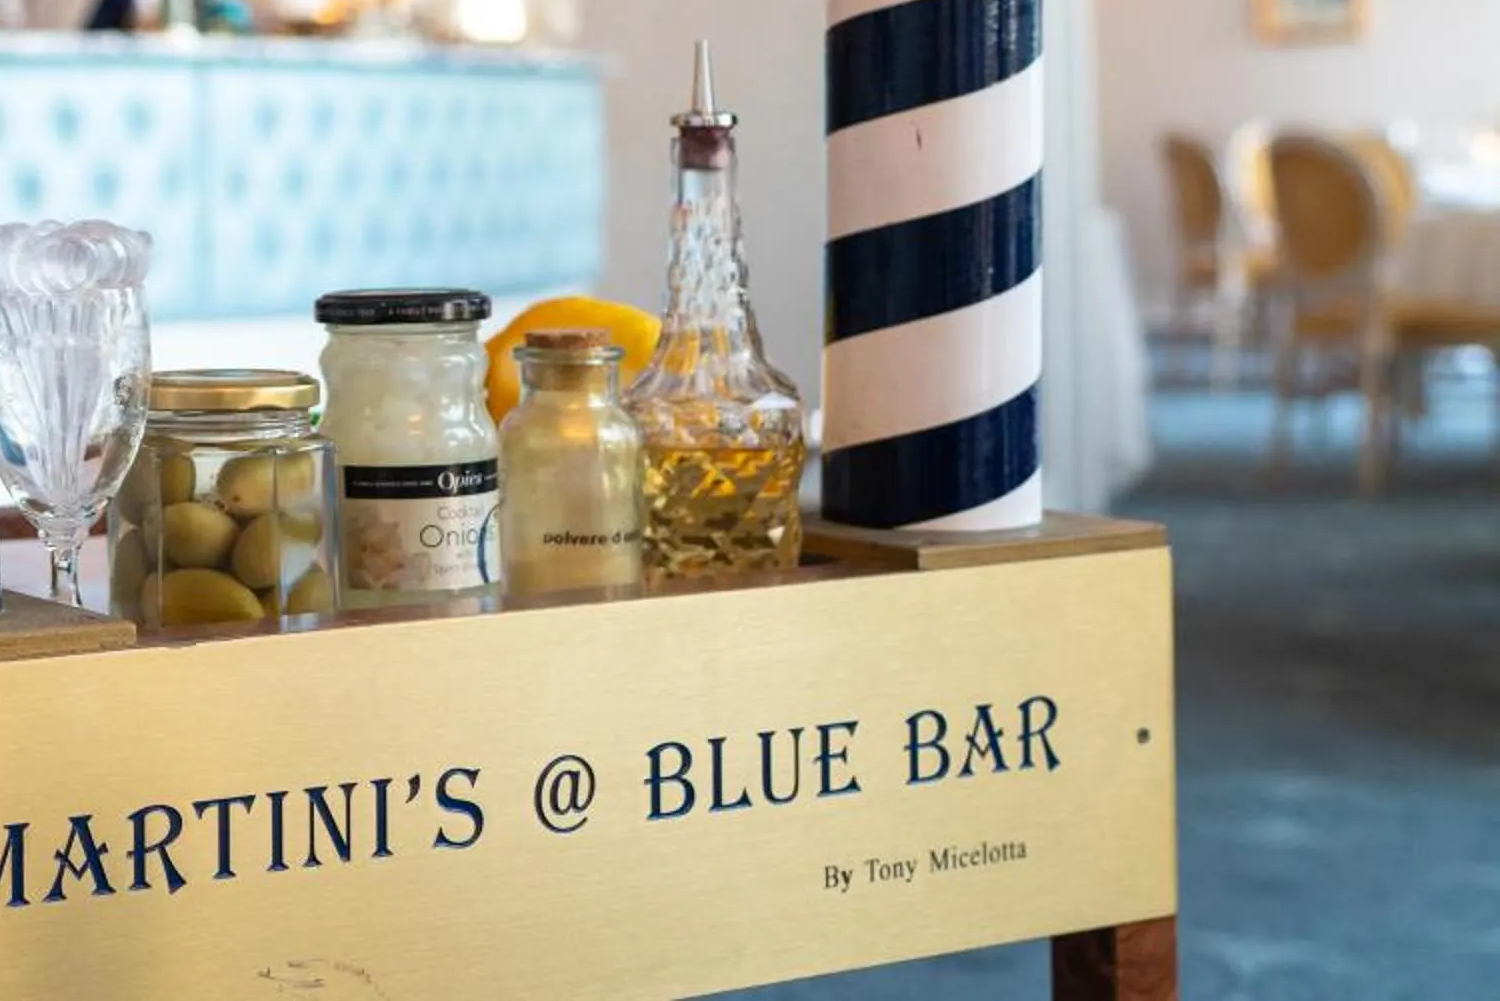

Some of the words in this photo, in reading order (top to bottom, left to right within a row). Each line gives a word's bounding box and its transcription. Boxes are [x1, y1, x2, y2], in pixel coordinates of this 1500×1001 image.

[437, 470, 483, 494] Opies
[534, 755, 596, 833] @
[644, 721, 862, 820] BLUE
[904, 695, 1061, 785] BAR
[823, 865, 854, 893] By
[865, 859, 917, 883] Tony
[929, 839, 1028, 873] Micelotta
